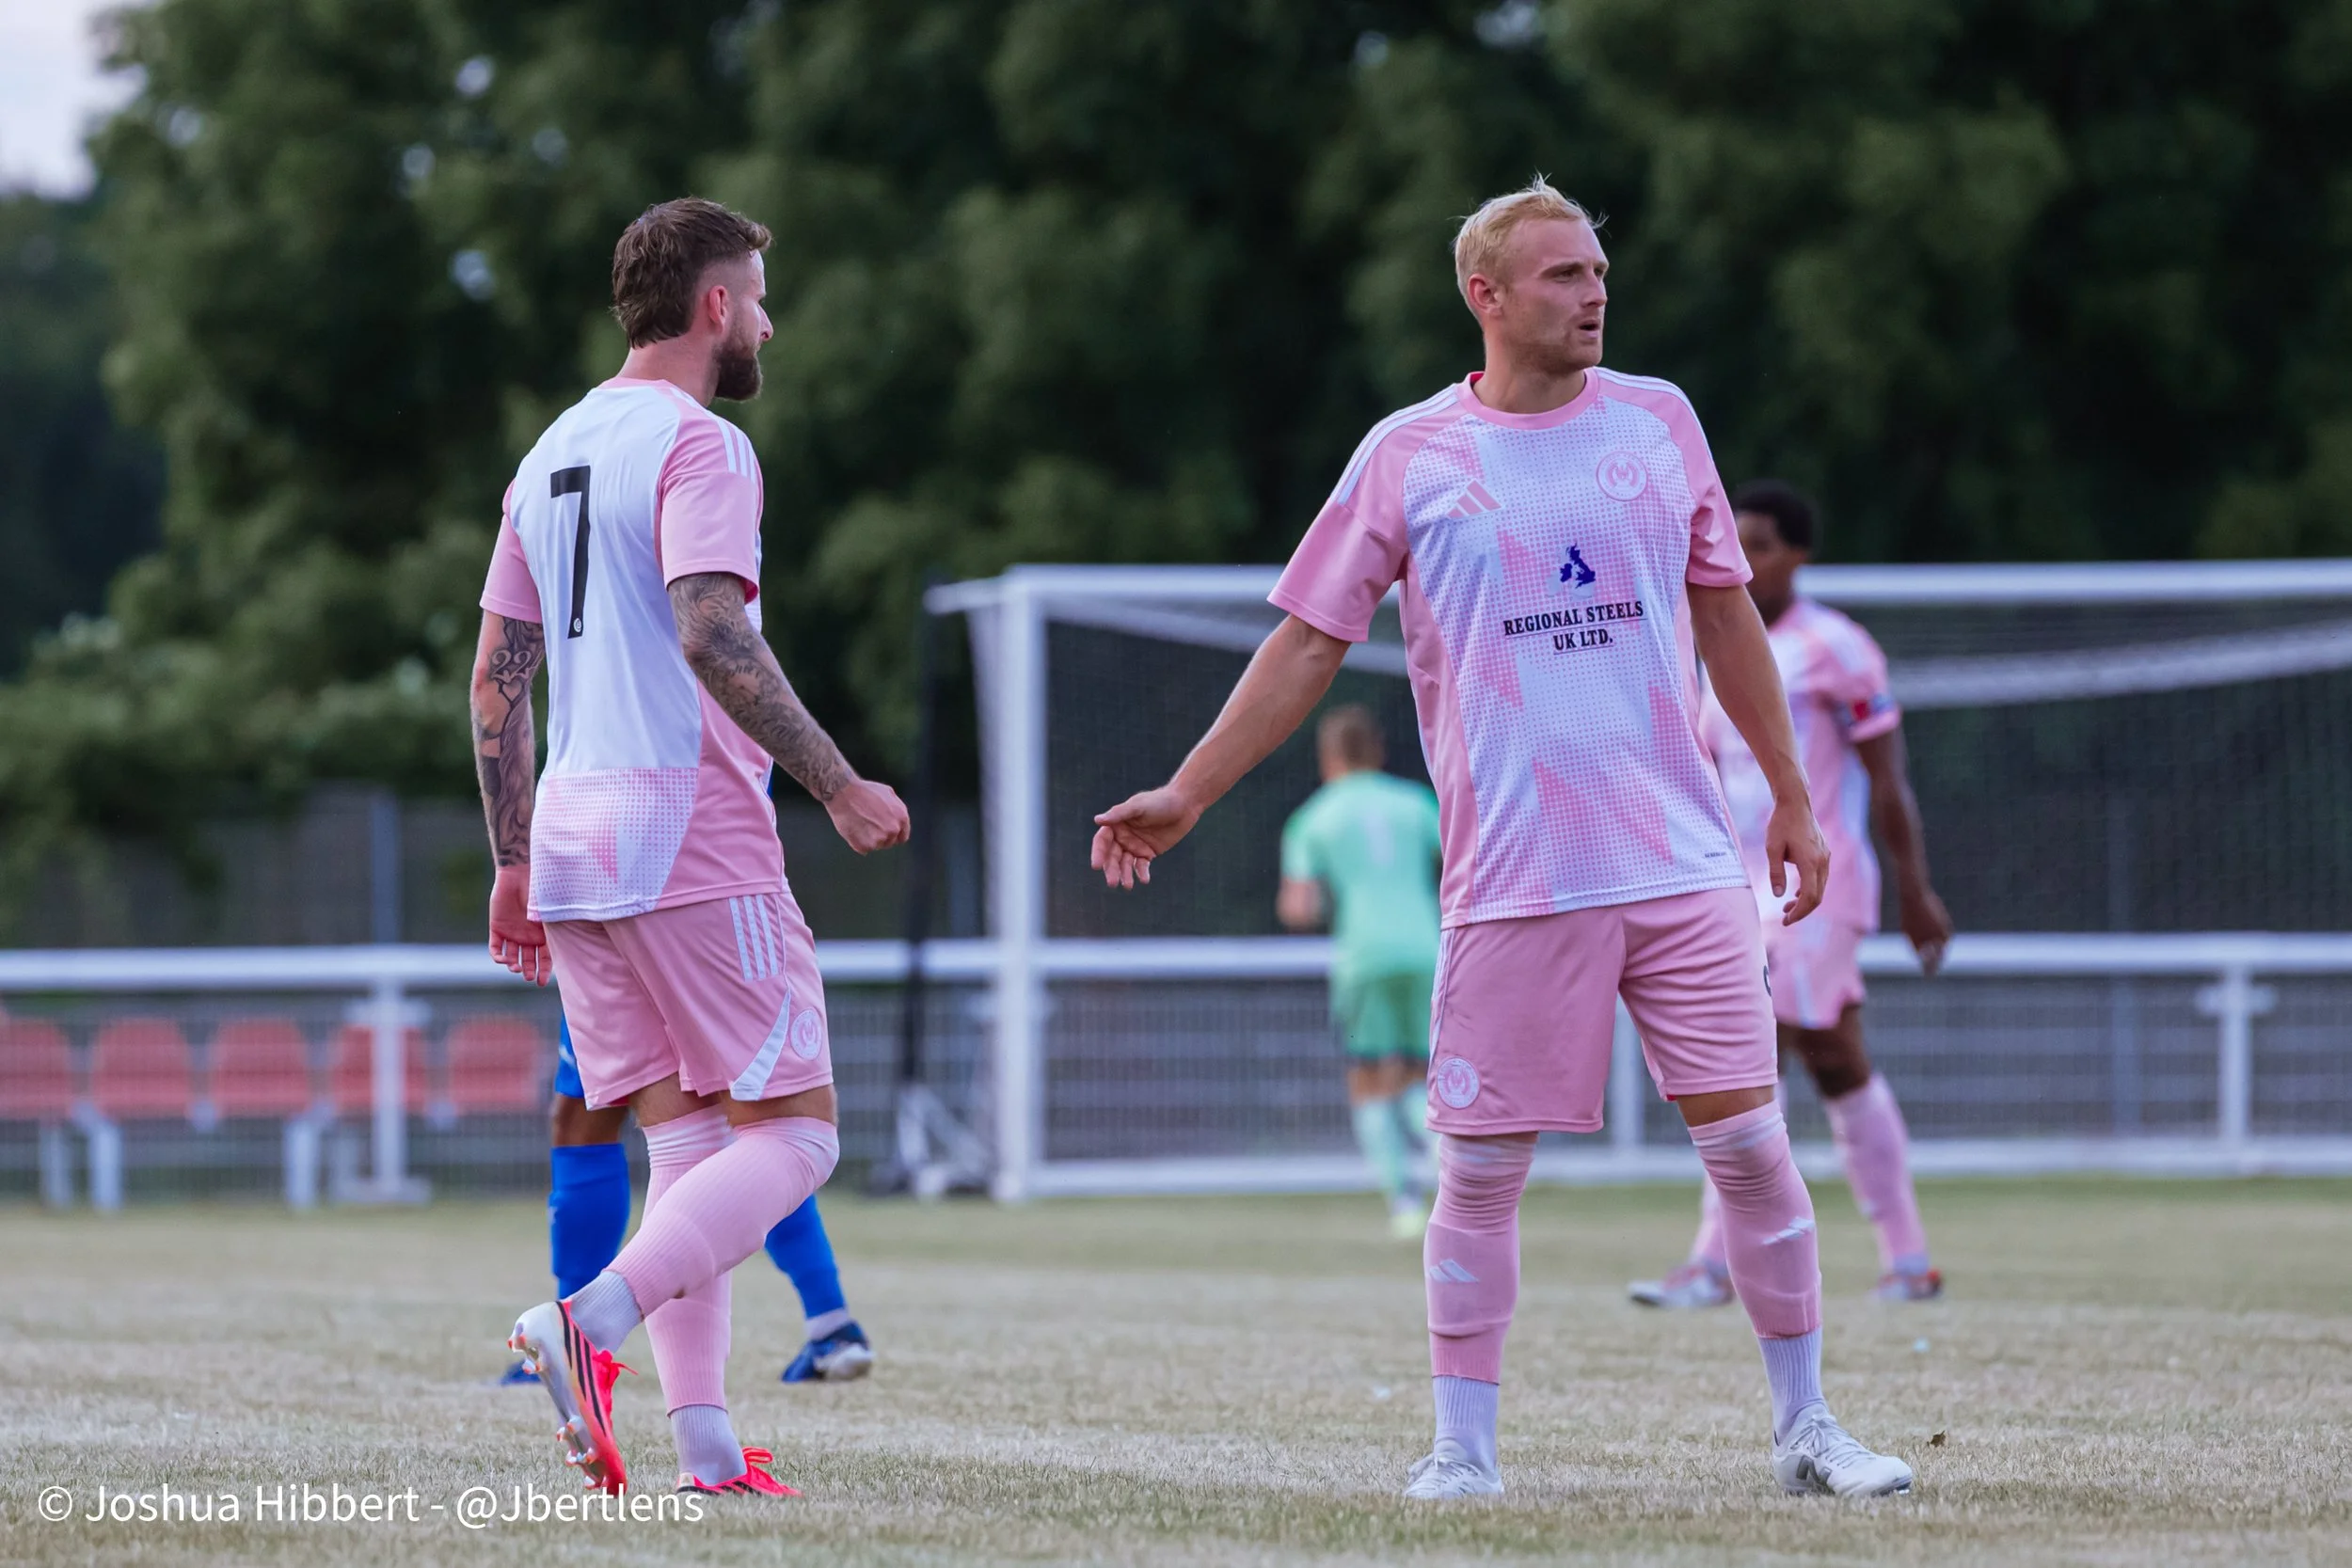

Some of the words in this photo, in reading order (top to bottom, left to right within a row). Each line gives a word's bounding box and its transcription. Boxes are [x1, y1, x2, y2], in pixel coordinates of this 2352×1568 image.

[550, 465, 591, 640] 7
[1503, 609, 1582, 636] REGIONAL
[1586, 601, 1644, 623] STEELS
[1553, 632, 1577, 651] UK
[1581, 627, 1613, 647] LTD.
